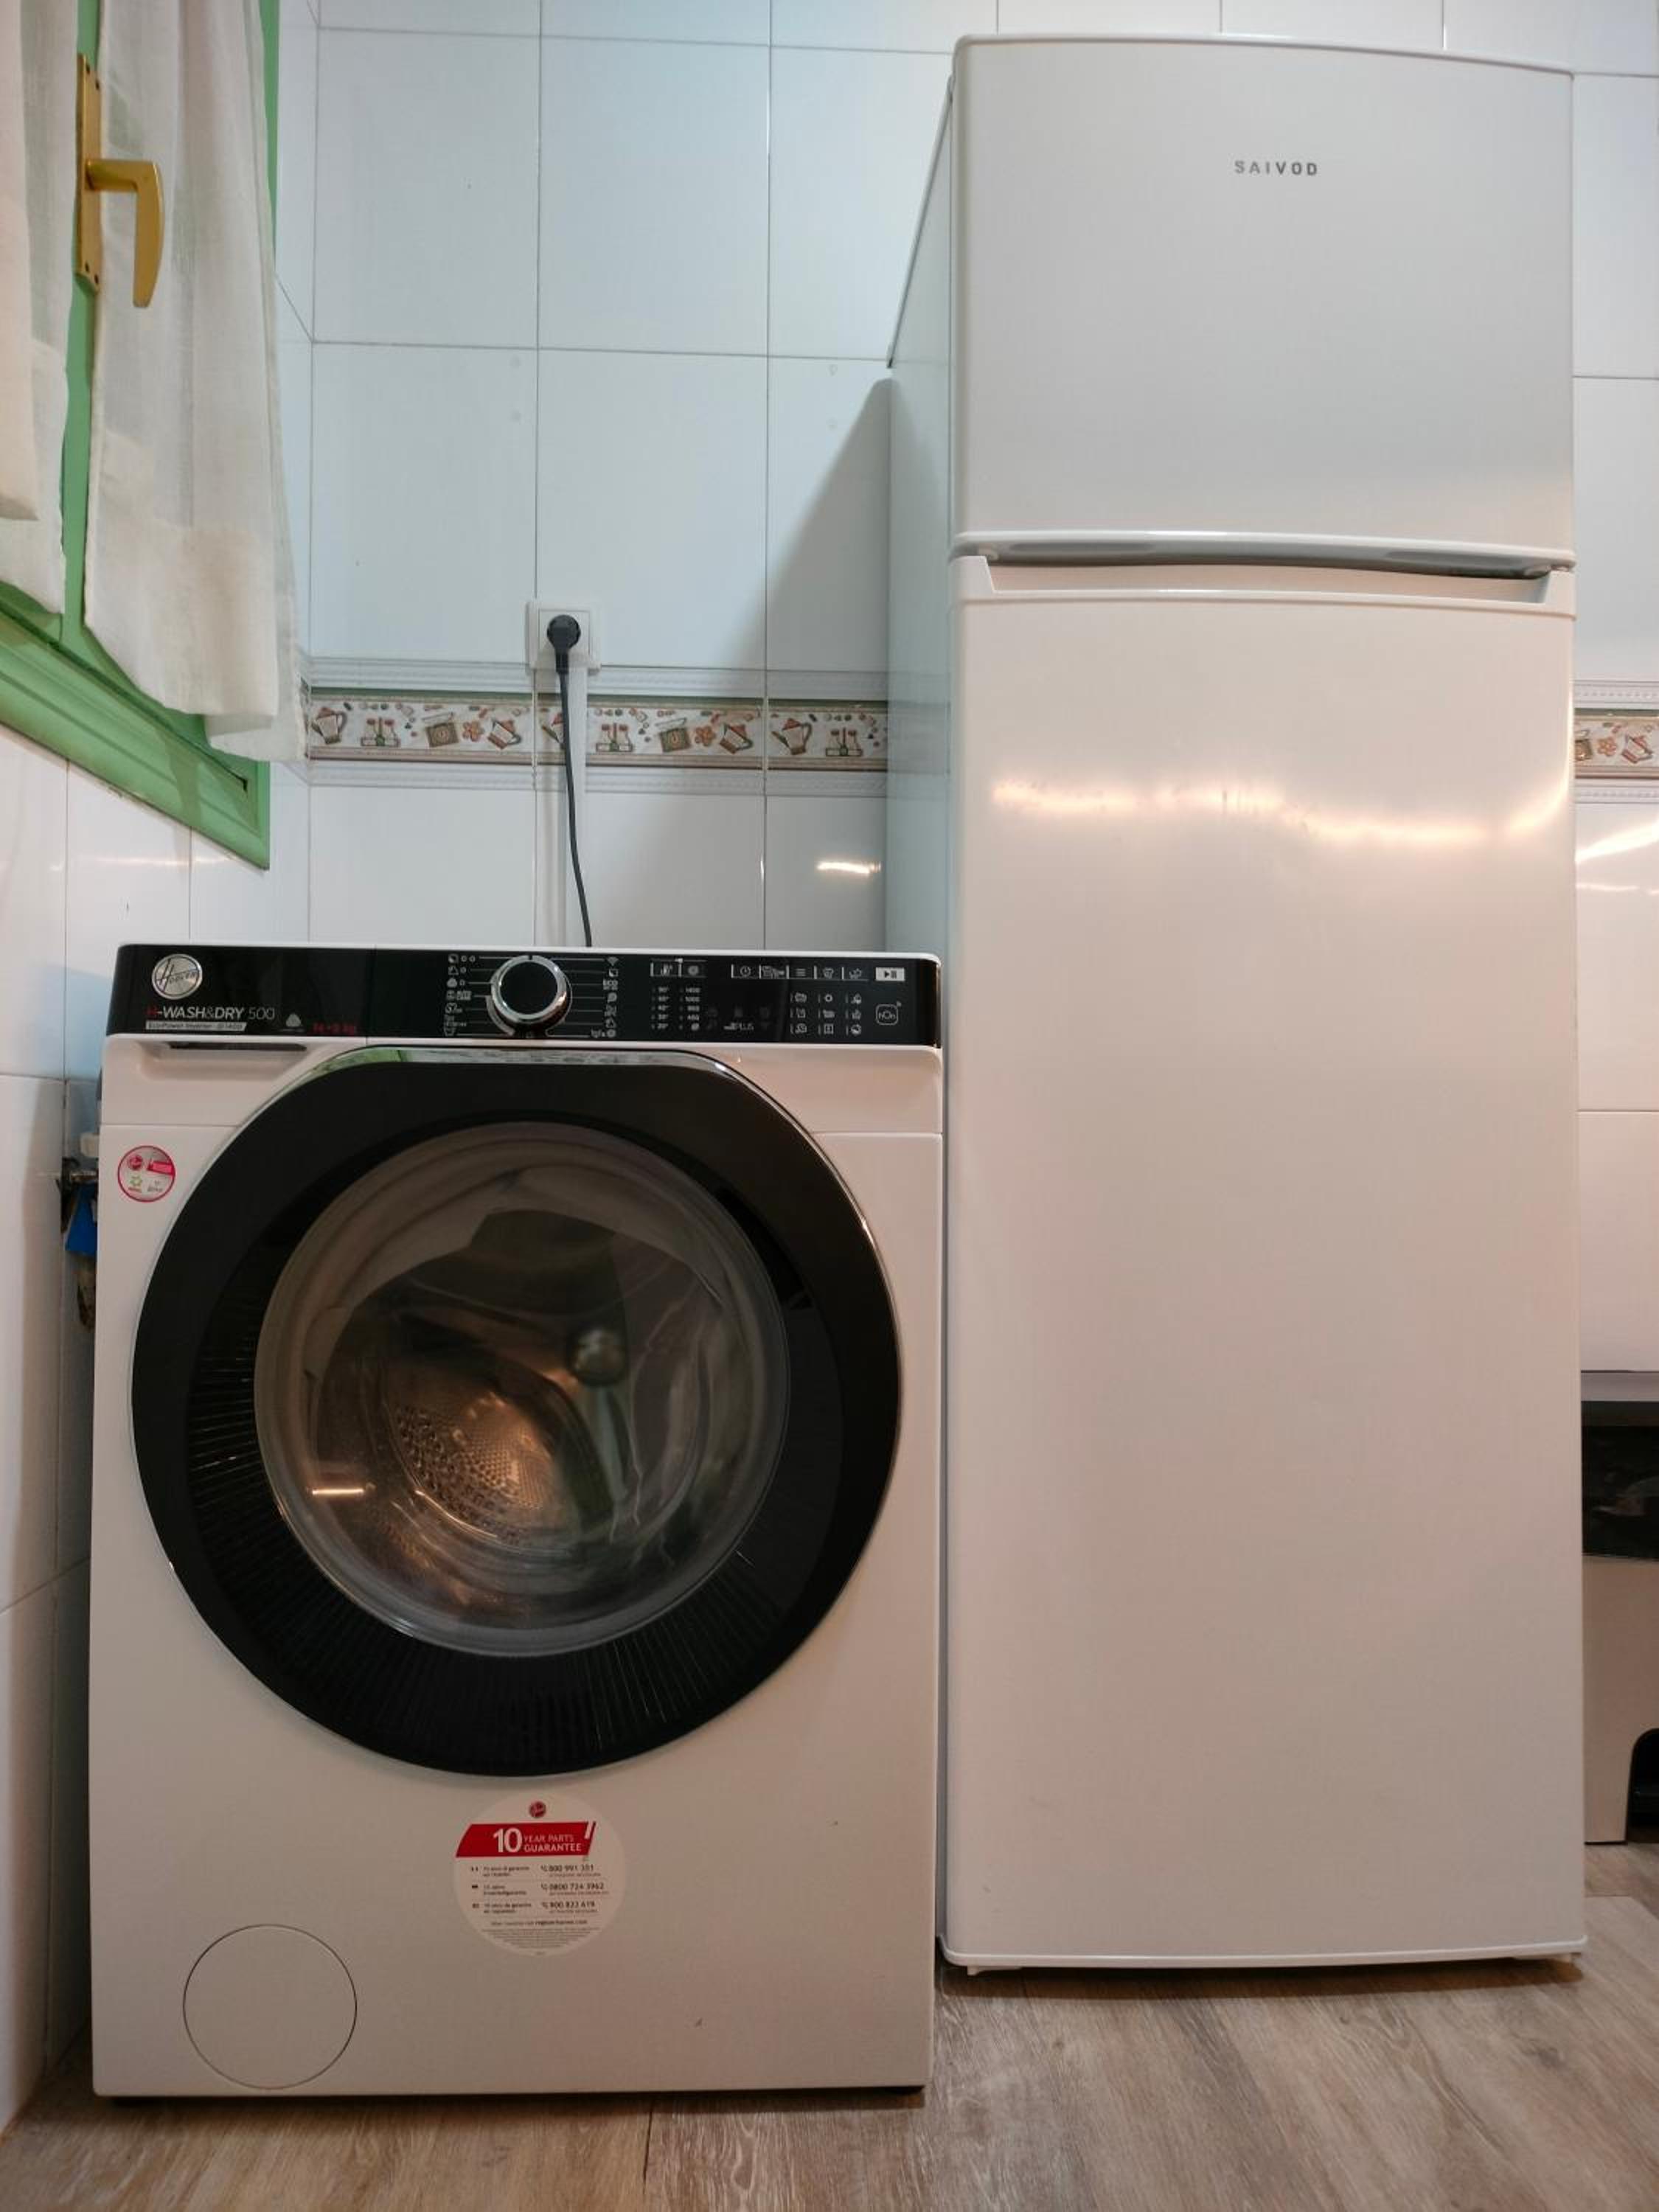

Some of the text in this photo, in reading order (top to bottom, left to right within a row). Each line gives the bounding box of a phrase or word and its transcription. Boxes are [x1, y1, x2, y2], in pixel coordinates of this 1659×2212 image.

[1234, 160, 1318, 176] SAIVOD
[248, 1006, 275, 1020] 500
[493, 1827, 574, 1853] 10 YEAR PARTS
[523, 1843, 582, 1852] GUARANTEE
